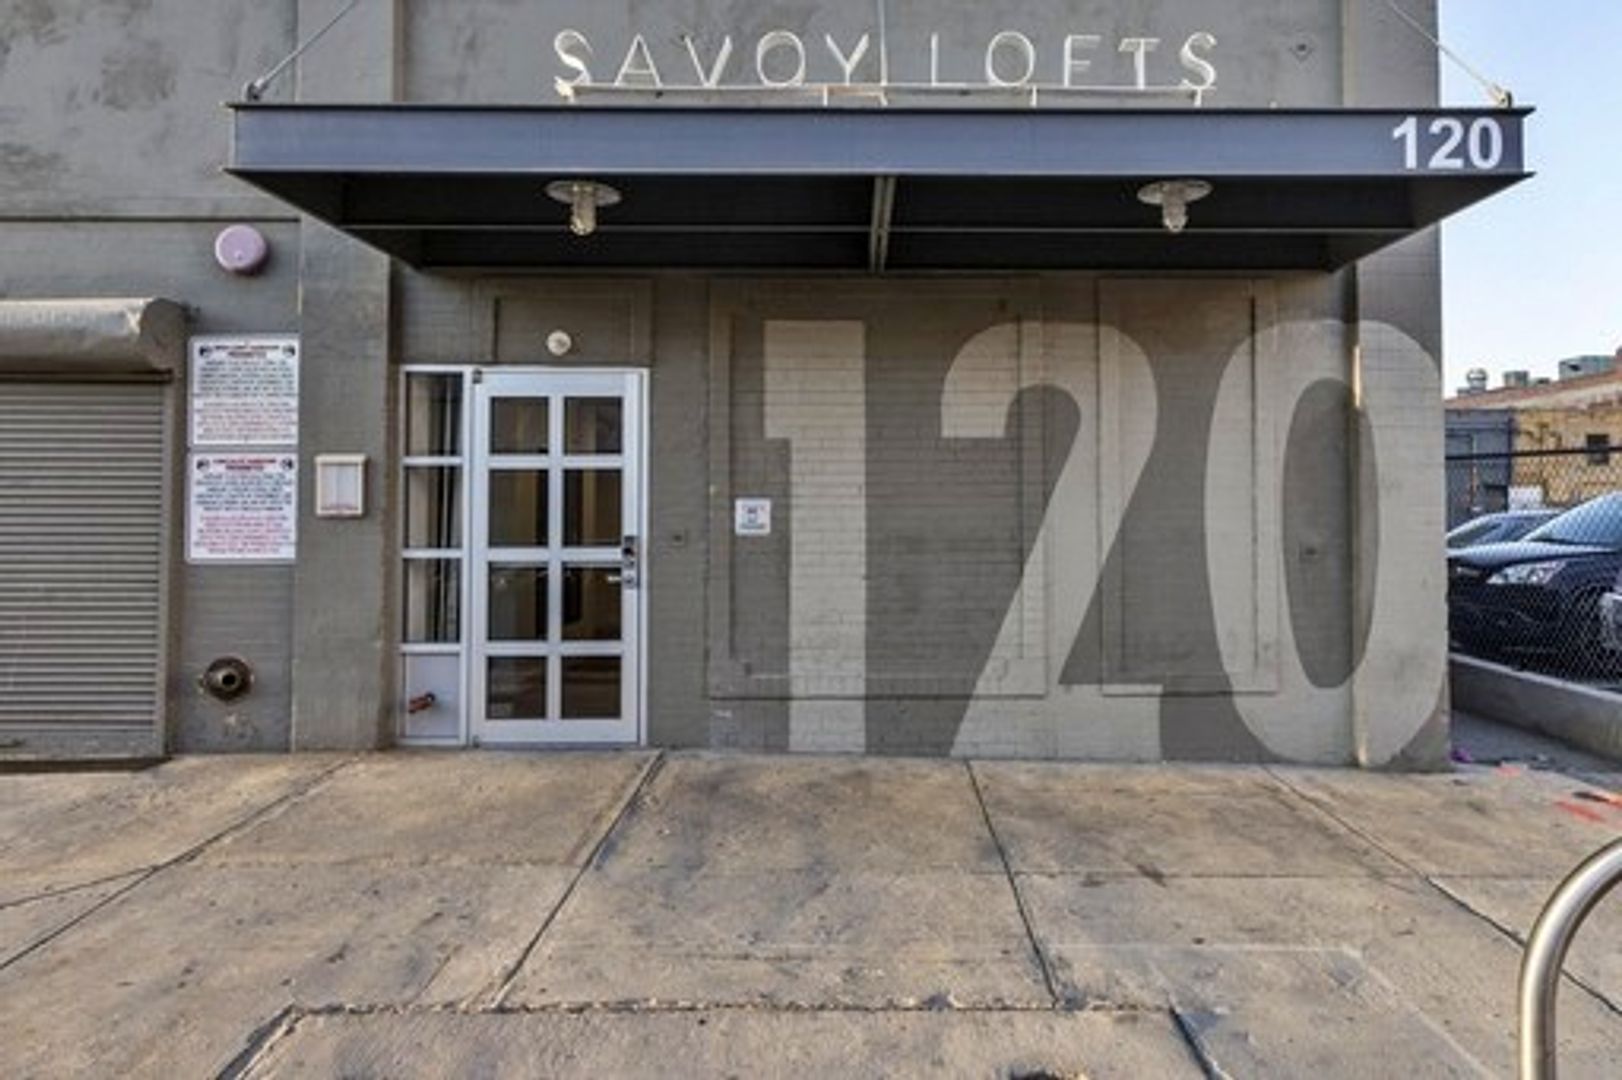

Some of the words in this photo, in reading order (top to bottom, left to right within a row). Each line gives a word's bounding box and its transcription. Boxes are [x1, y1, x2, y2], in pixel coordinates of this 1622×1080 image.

[553, 30, 870, 88] SAVOY
[930, 30, 1219, 88] LOFTS
[1392, 116, 1503, 170] 120
[763, 320, 1447, 767] 120
